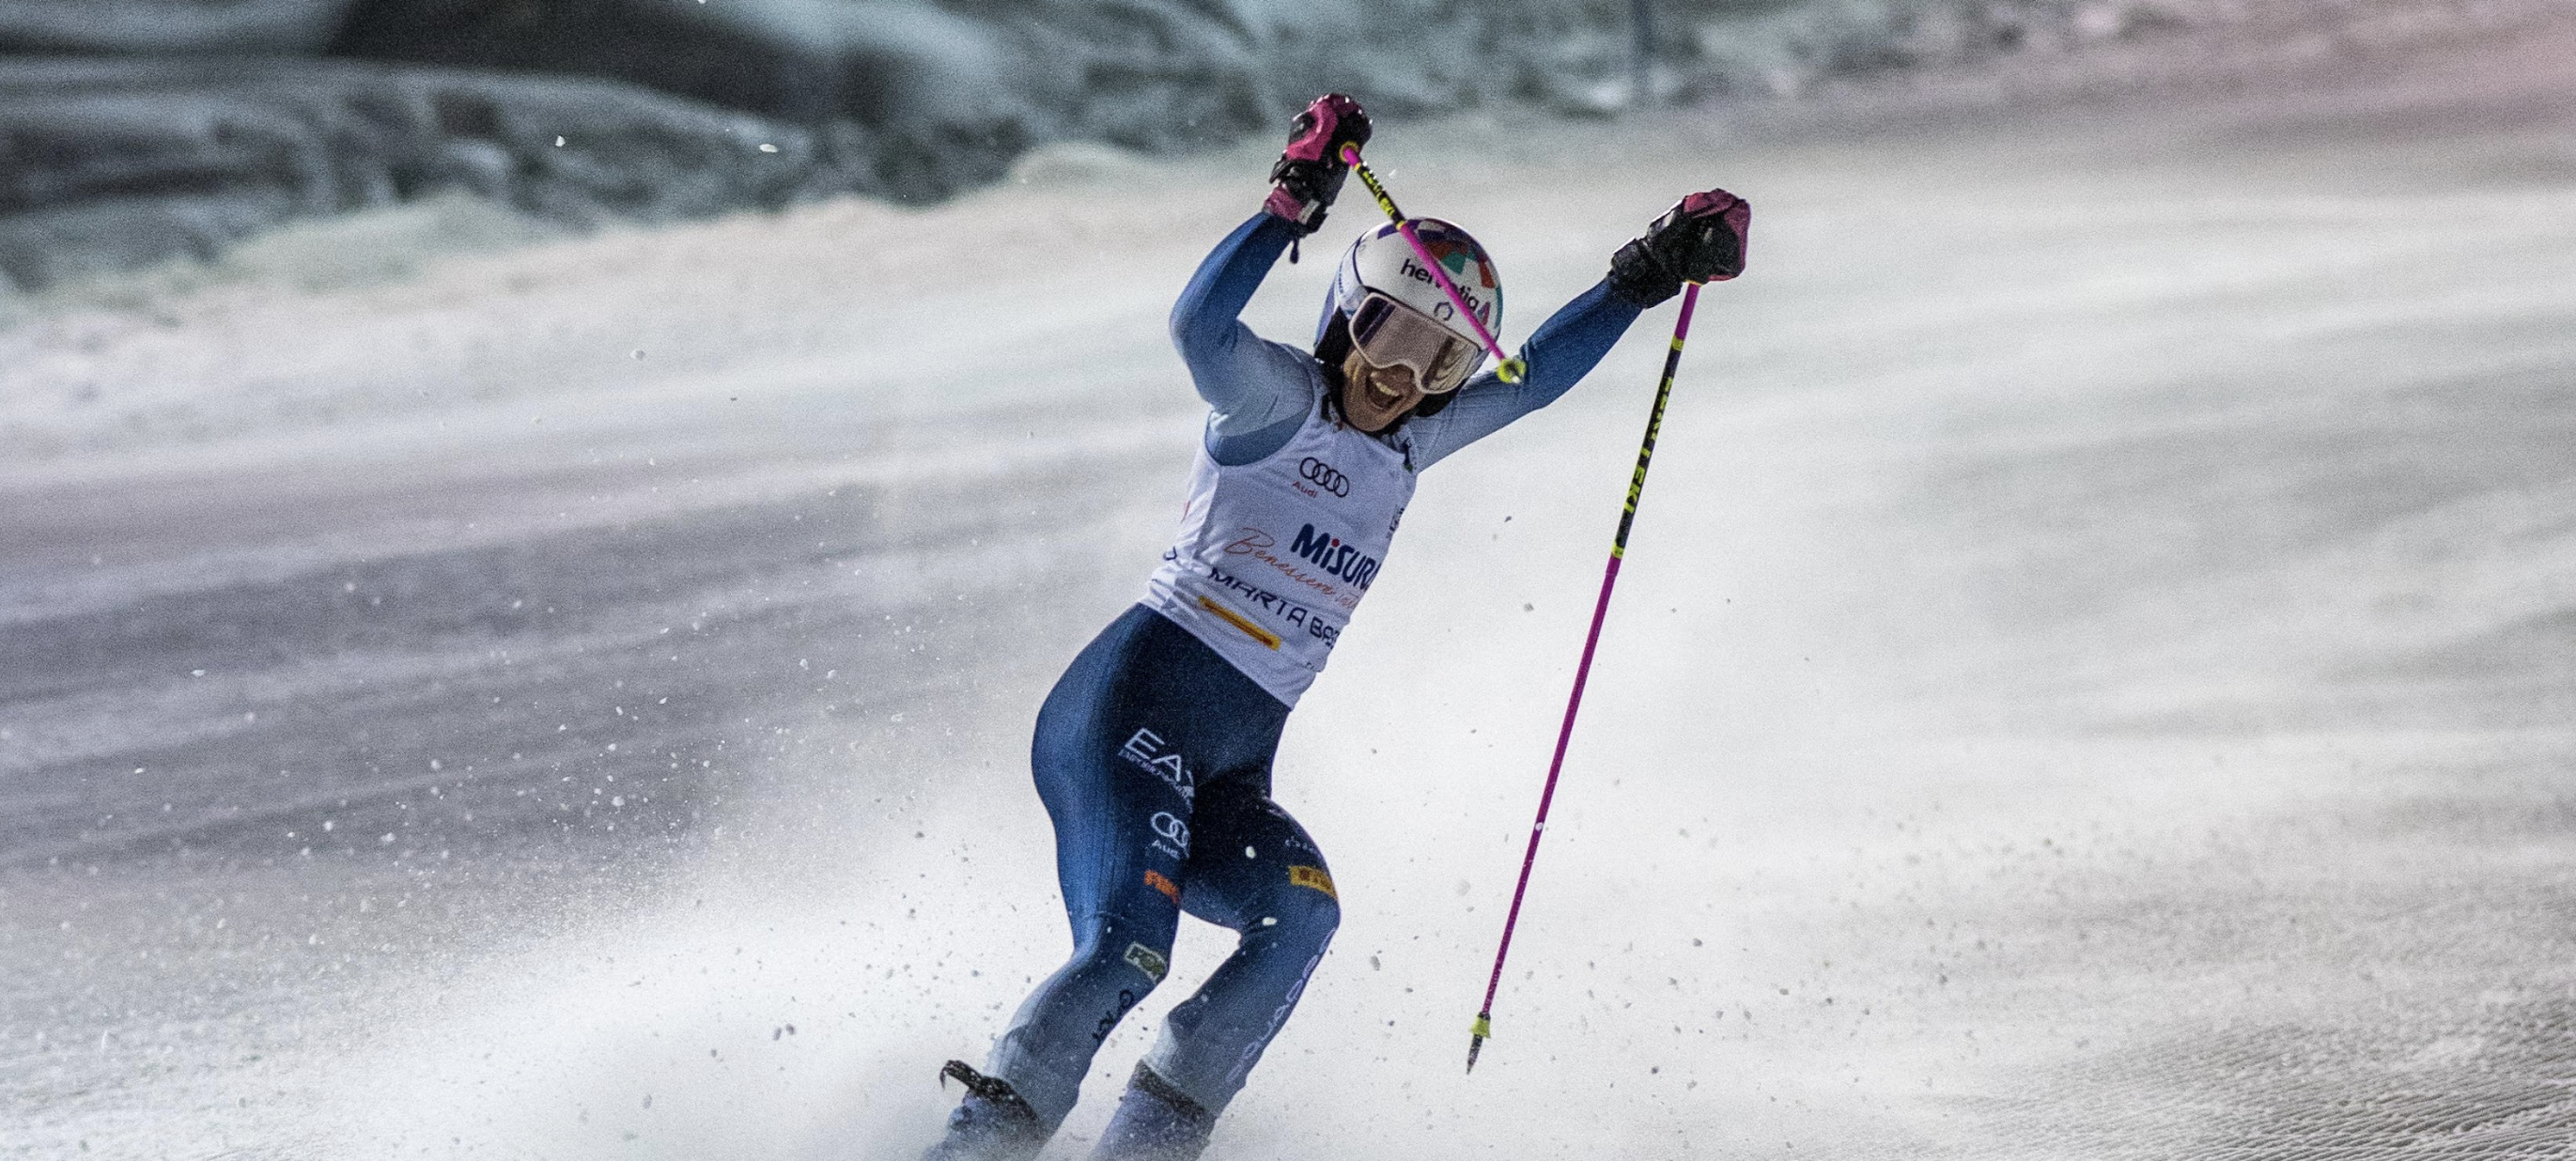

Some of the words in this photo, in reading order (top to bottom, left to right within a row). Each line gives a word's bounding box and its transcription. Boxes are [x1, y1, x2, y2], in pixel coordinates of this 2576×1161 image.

[1400, 258, 1480, 313] hetia
[1292, 480, 1318, 499] Audi
[1207, 566, 1308, 627] MARTA
